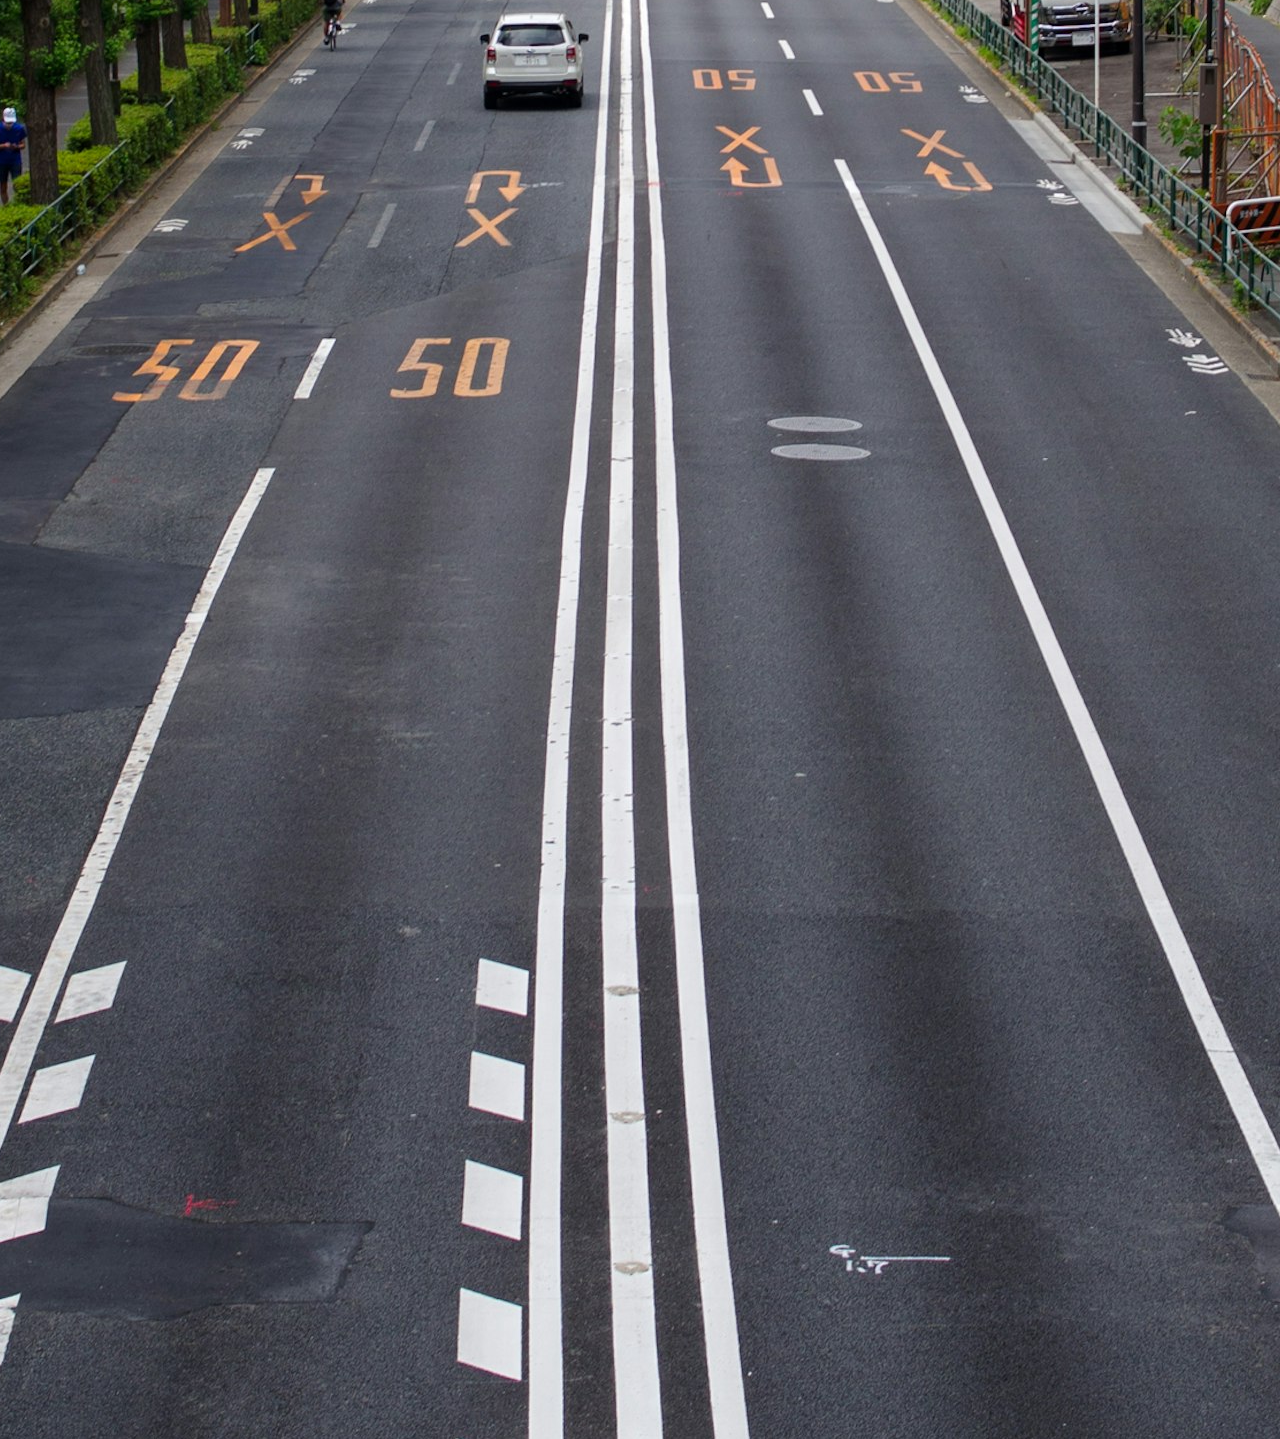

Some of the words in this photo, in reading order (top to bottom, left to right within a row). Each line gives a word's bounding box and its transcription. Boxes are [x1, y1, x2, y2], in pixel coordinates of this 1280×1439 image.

[692, 69, 757, 90] 50
[853, 71, 922, 92] 50
[112, 339, 260, 402] 50
[390, 338, 511, 398] 50
